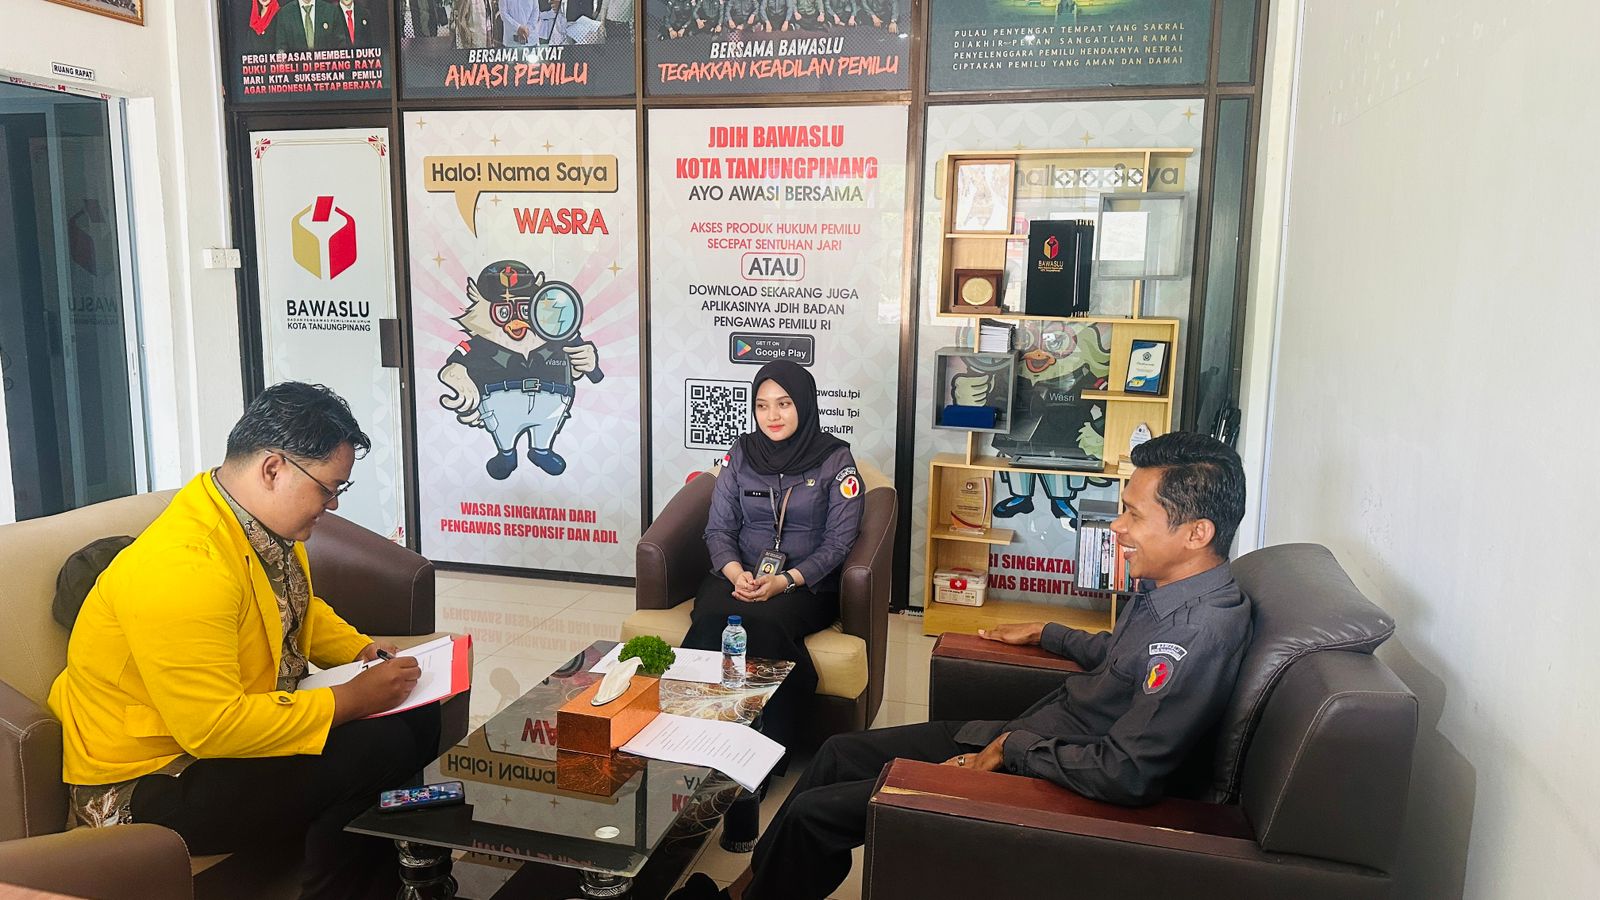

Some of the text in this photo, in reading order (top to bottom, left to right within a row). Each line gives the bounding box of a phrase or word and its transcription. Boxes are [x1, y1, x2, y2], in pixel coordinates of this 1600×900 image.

[954, 22, 1185, 38] PULAU PENYENGAT TEMPAT YANG SAKRAL
[1060, 35, 1133, 45] SANGATLAH
[1143, 34, 1183, 42] RAMAI
[469, 47, 564, 63] BERSAMA RAKYAT
[710, 37, 844, 59] BERSAMA BAWASLU
[953, 45, 1184, 60] PENYELENGGARA PEMILU HENDAKNYA NETRAL
[242, 48, 381, 64] PERGI KEPASAR MEMBELI DUKU
[952, 56, 1183, 70] CIPTAKAN PEMILU YANG AMAN DAN DAMAI
[54, 64, 92, 79] RUANG RAPAT
[242, 59, 381, 75] DUKU DIBELI DI PETANG RAYA
[657, 55, 899, 82] TEGAKKAN KEADILAN PEMILU
[243, 70, 382, 85] MARI KITA SUKSESKAN PEMILU
[444, 62, 588, 89] AWASI PEMILU
[244, 80, 382, 95] AGAR INDONESIA TETAP BERJAYA
[708, 125, 844, 148] JDIH BAWASLU
[432, 162, 607, 186] Halo! Nama Saya
[676, 156, 878, 179] KOTA TANJUNGPINANG
[688, 185, 863, 201] AYO AWASI BERSAMA
[513, 207, 609, 235] WASRA
[690, 222, 861, 235] AKSES PRODUK HUKUM PEMILU
[707, 238, 842, 251] SECEPAT SENTUHAN JARI
[748, 257, 799, 277] ATAU
[1038, 260, 1064, 268] BAWASLU
[689, 284, 859, 300] DOWNLOAD SEKARANG JUGA
[286, 299, 370, 318] BAWASLU
[701, 300, 845, 315] APLIKASINYA JDIH BADAN
[287, 322, 371, 332] KOTA TANJUNGPINANG
[714, 316, 831, 330] PENGAWAS PEMILU RI
[755, 348, 807, 360] Google Play
[545, 358, 567, 367] Wasra
[816, 389, 861, 400] awaslu.tpi
[817, 407, 860, 419] waslu Tpi
[820, 425, 854, 434] asluTPI
[460, 501, 597, 524] WASRA SINGKATAN DARI
[440, 518, 619, 544] PENGAWAS RESPONSIF DAN ADIL
